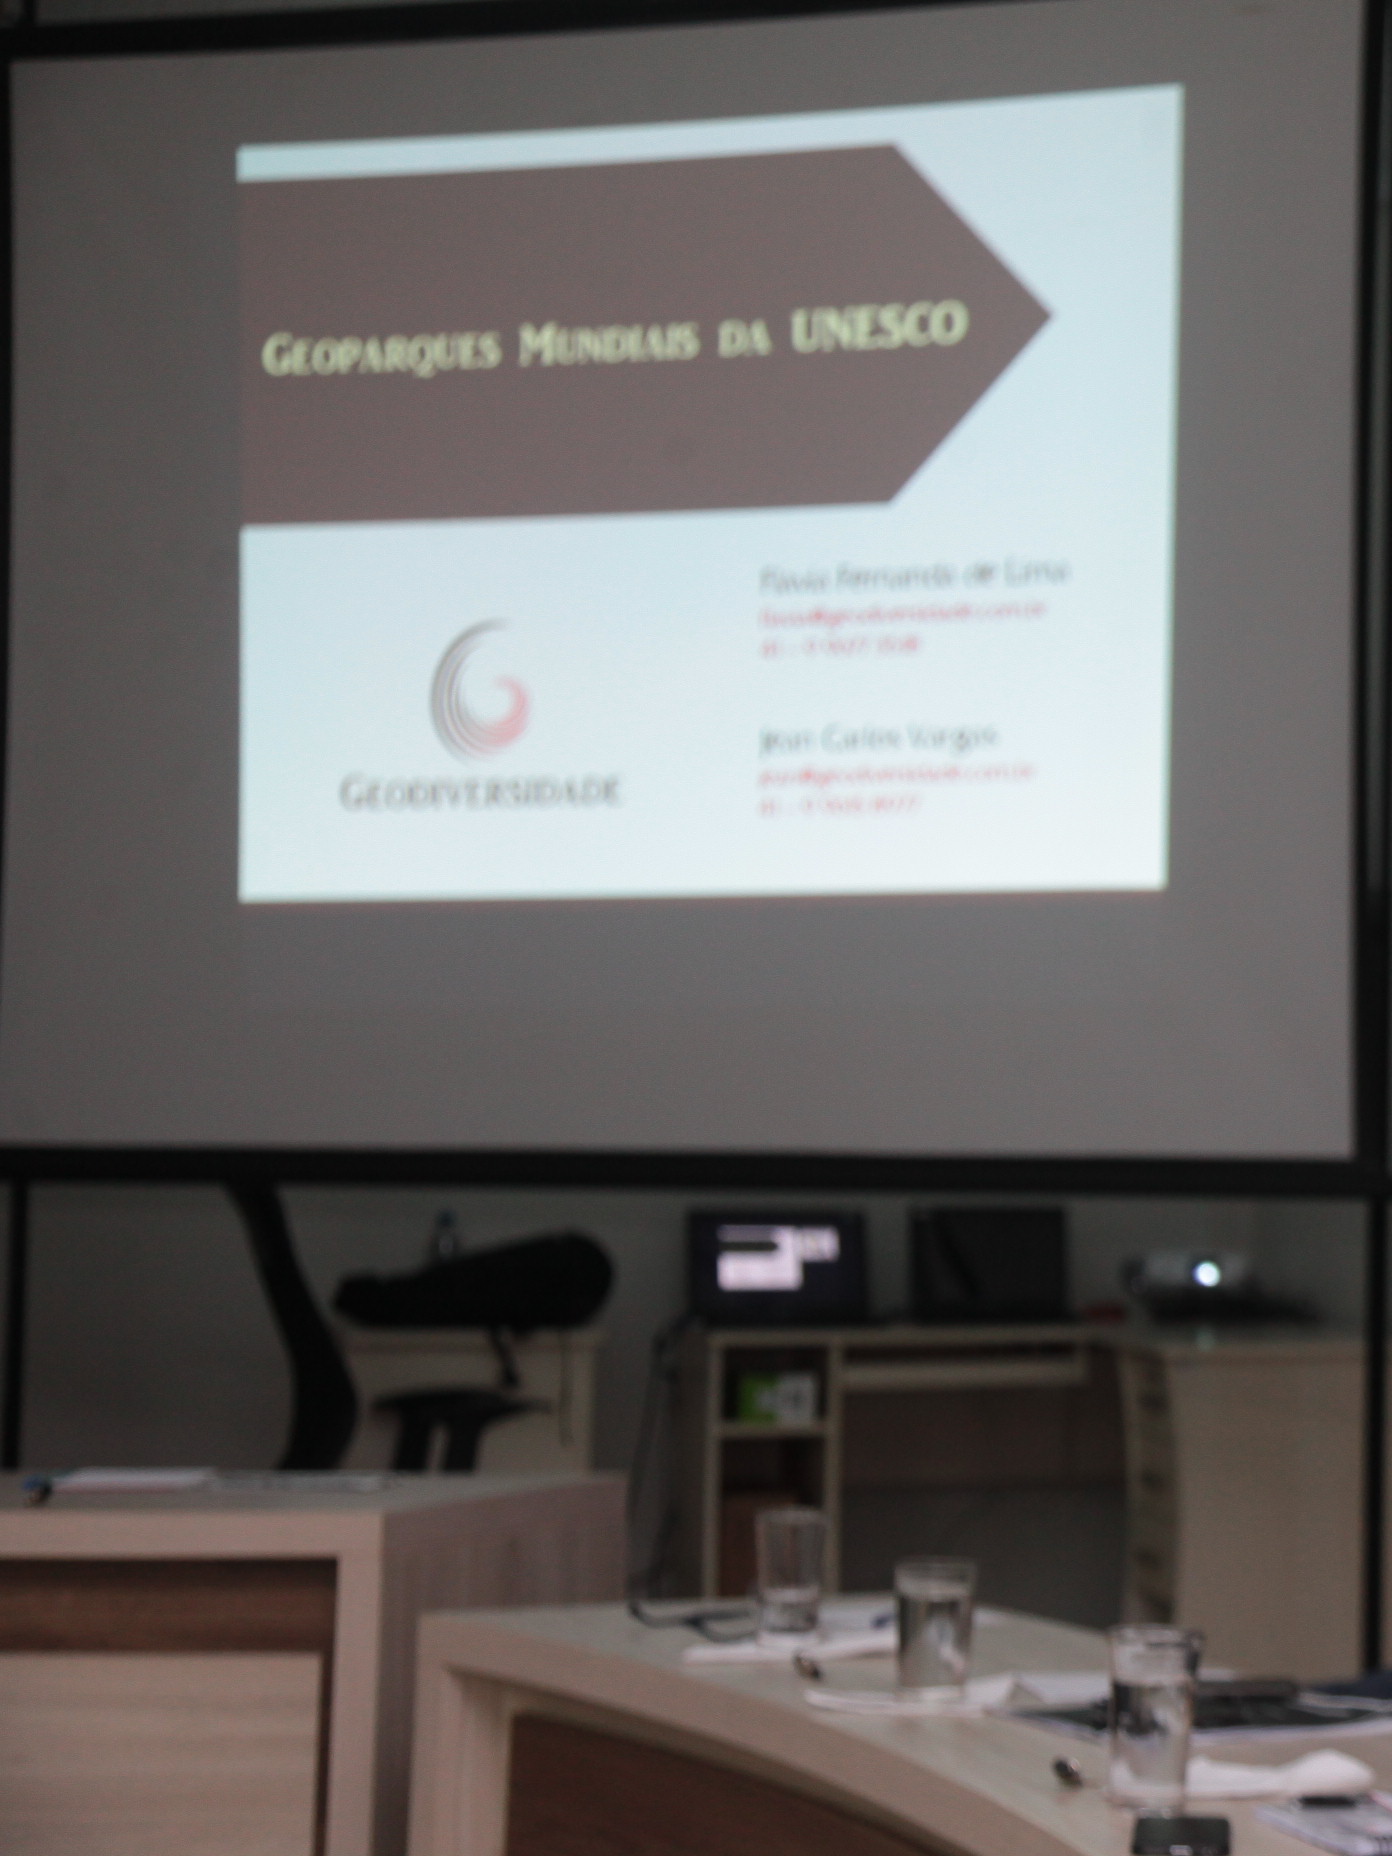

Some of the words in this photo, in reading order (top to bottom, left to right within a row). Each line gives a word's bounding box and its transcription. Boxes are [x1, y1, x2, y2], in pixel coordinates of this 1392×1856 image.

[261, 331, 502, 378] GEOPARQUES
[518, 320, 700, 367] MUNDIAIS
[717, 319, 772, 358] DA
[790, 299, 970, 353] UNESCO
[340, 771, 624, 813] GEODIVERSIDADE
